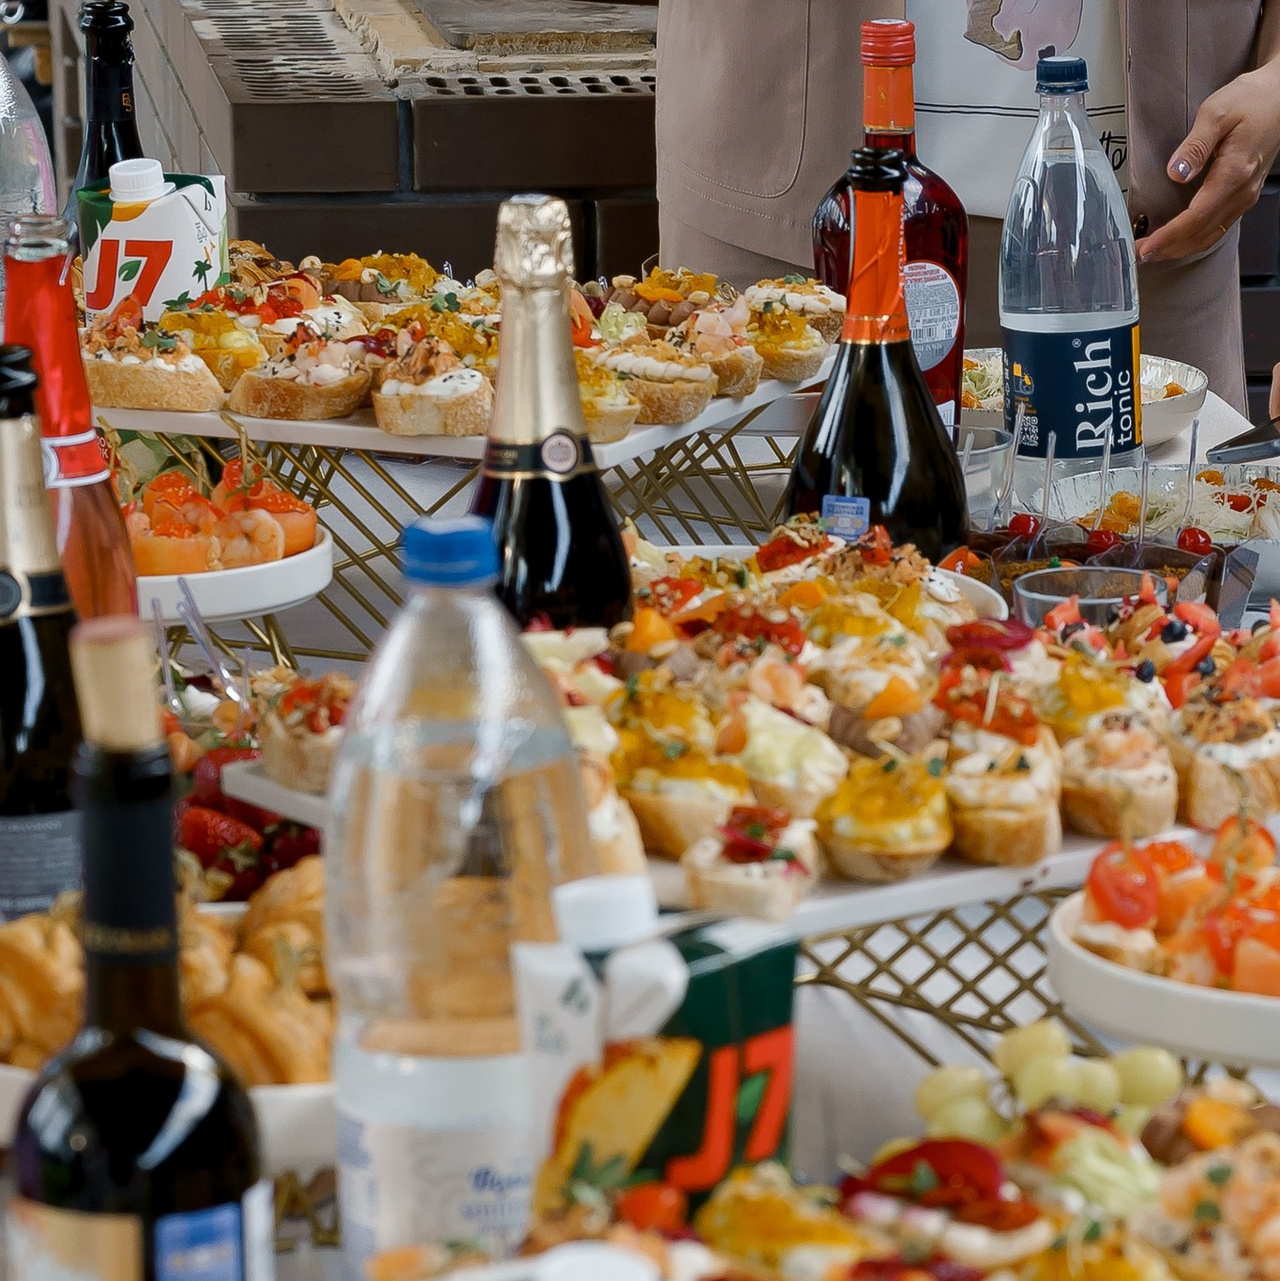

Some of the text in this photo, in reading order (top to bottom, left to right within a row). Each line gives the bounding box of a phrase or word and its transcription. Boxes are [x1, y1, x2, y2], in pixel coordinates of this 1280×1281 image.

[86, 239, 173, 310] J7
[1073, 337, 1115, 451] Rich
[1114, 369, 1133, 445] tonic
[663, 1022, 794, 1192] J7
